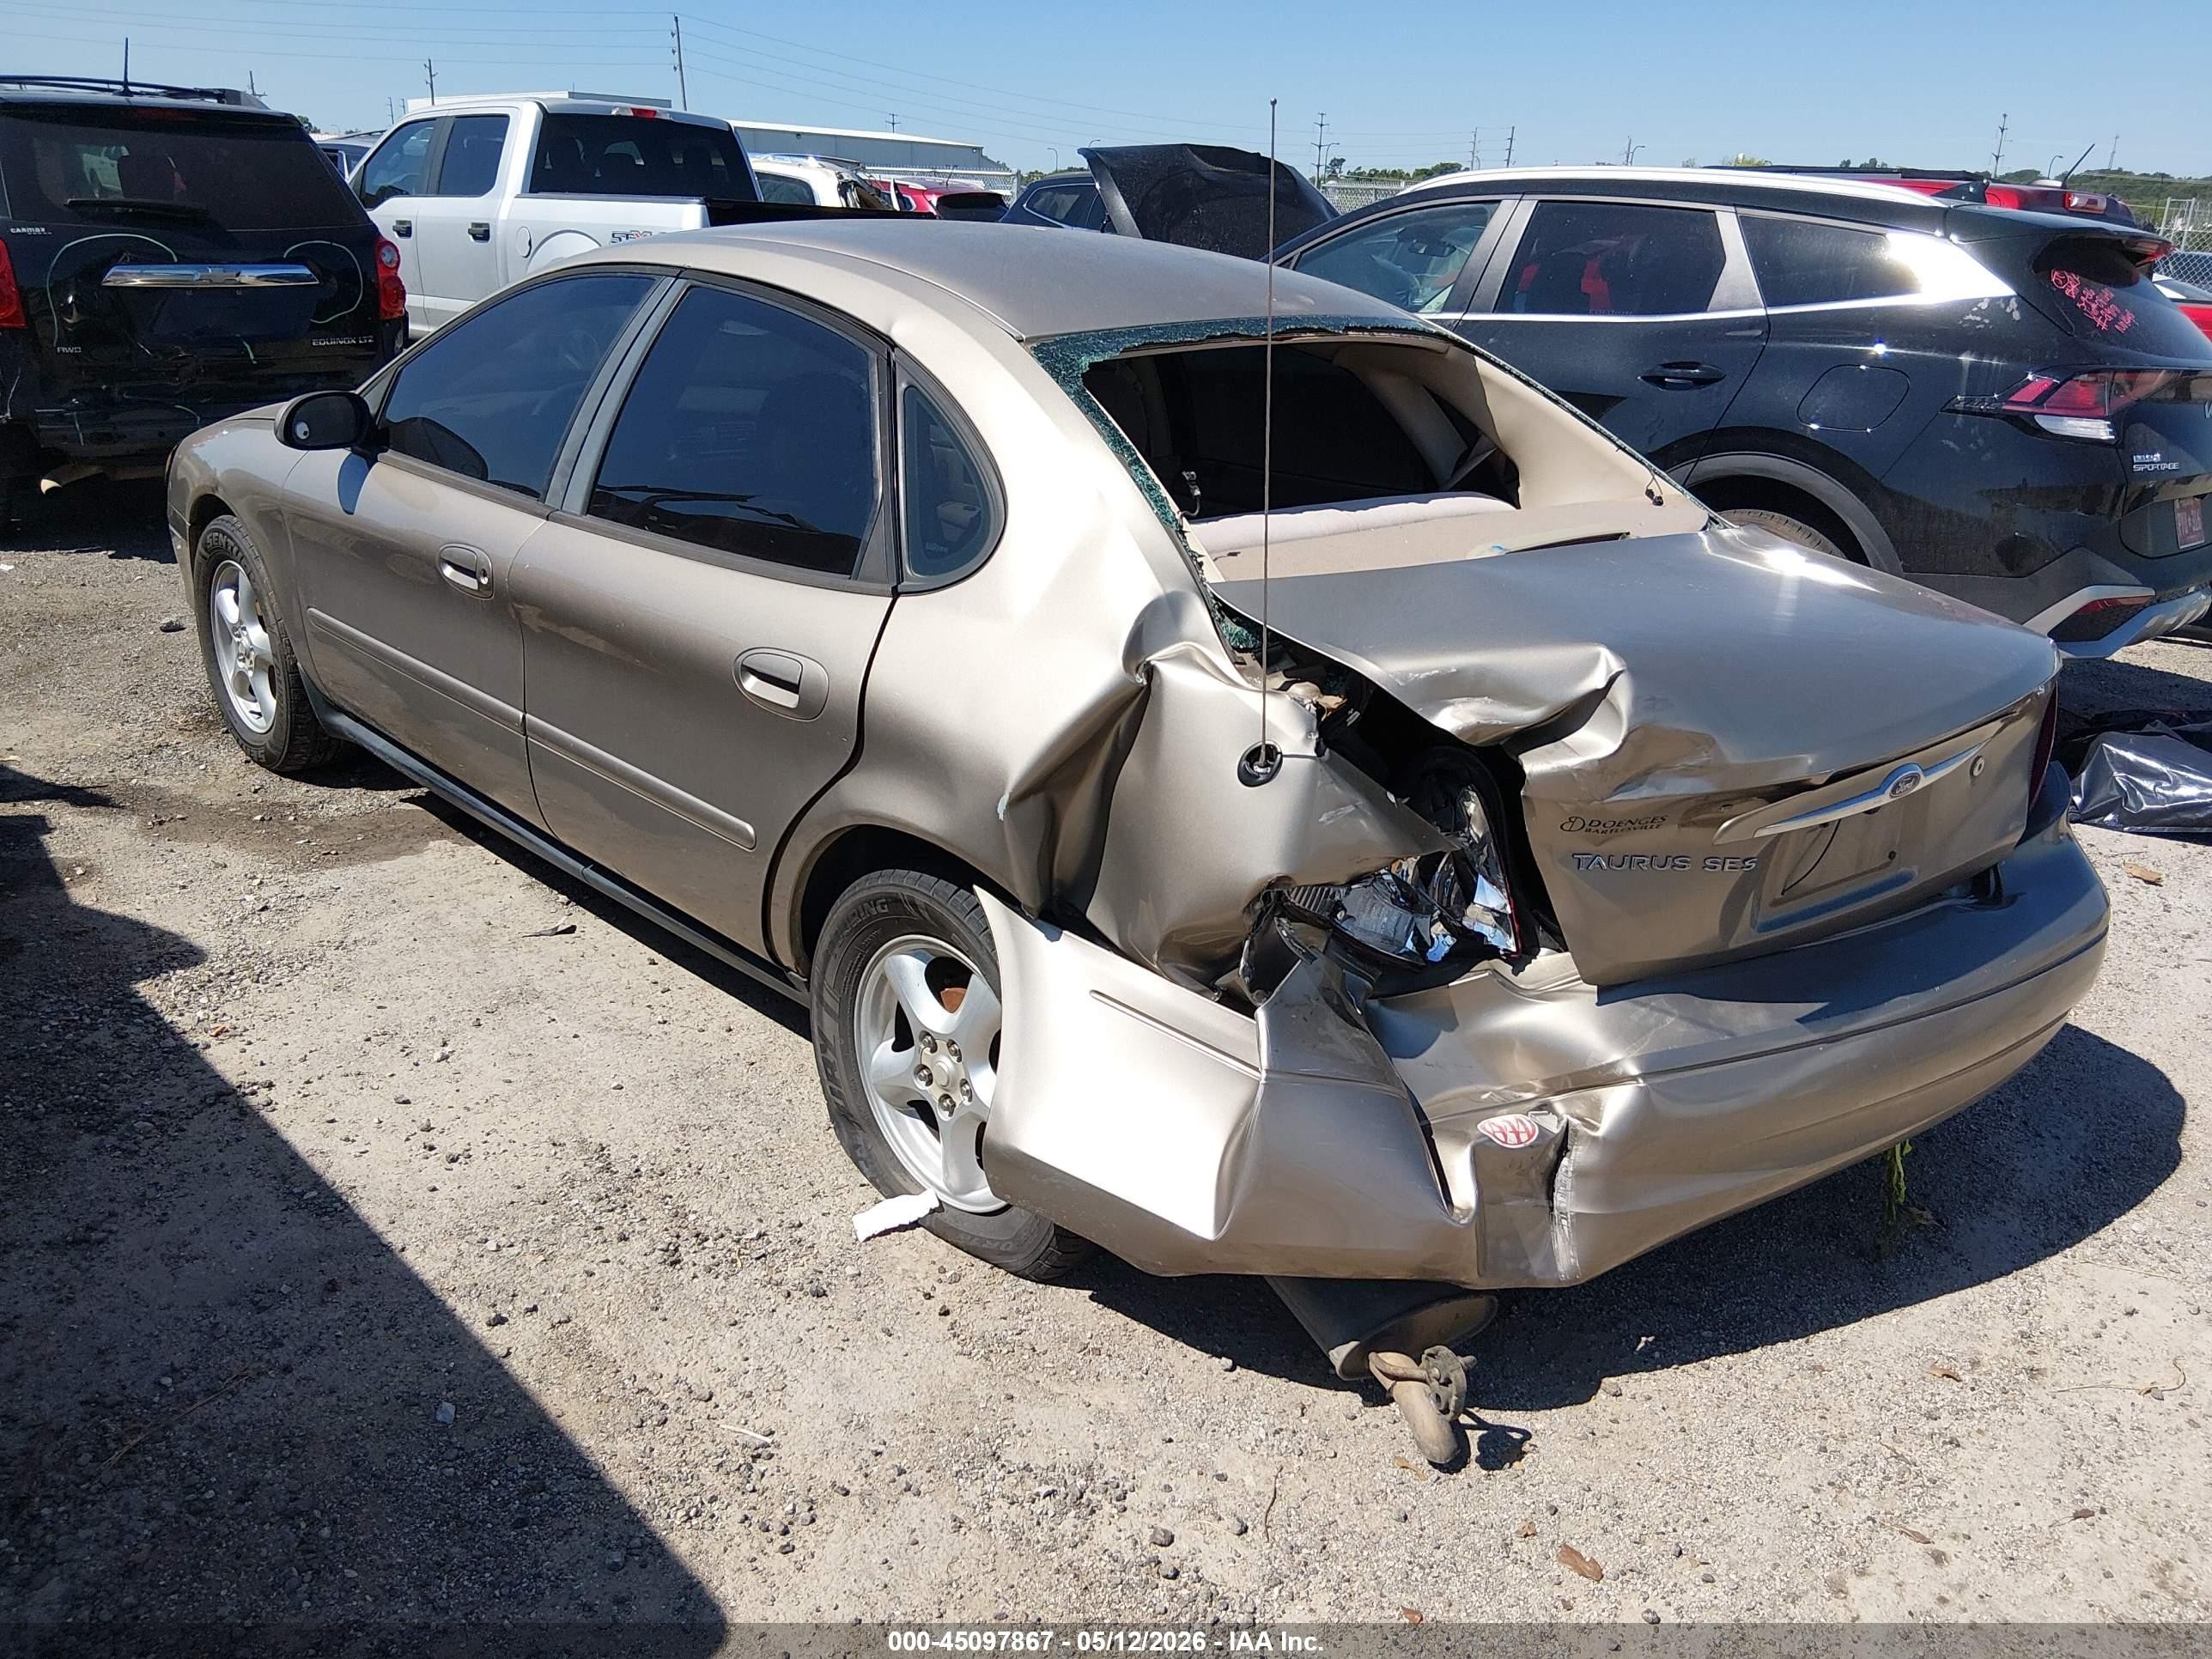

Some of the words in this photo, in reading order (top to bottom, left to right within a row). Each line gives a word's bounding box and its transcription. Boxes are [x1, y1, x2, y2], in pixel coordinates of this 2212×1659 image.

[312, 337, 356, 346] EQUINOX
[358, 335, 374, 343] LTZ
[2132, 462, 2180, 472] SPORTAGE
[1588, 815, 1669, 829] DOENGES
[1571, 853, 1691, 872] TAURUS
[1703, 856, 1759, 872] SES
